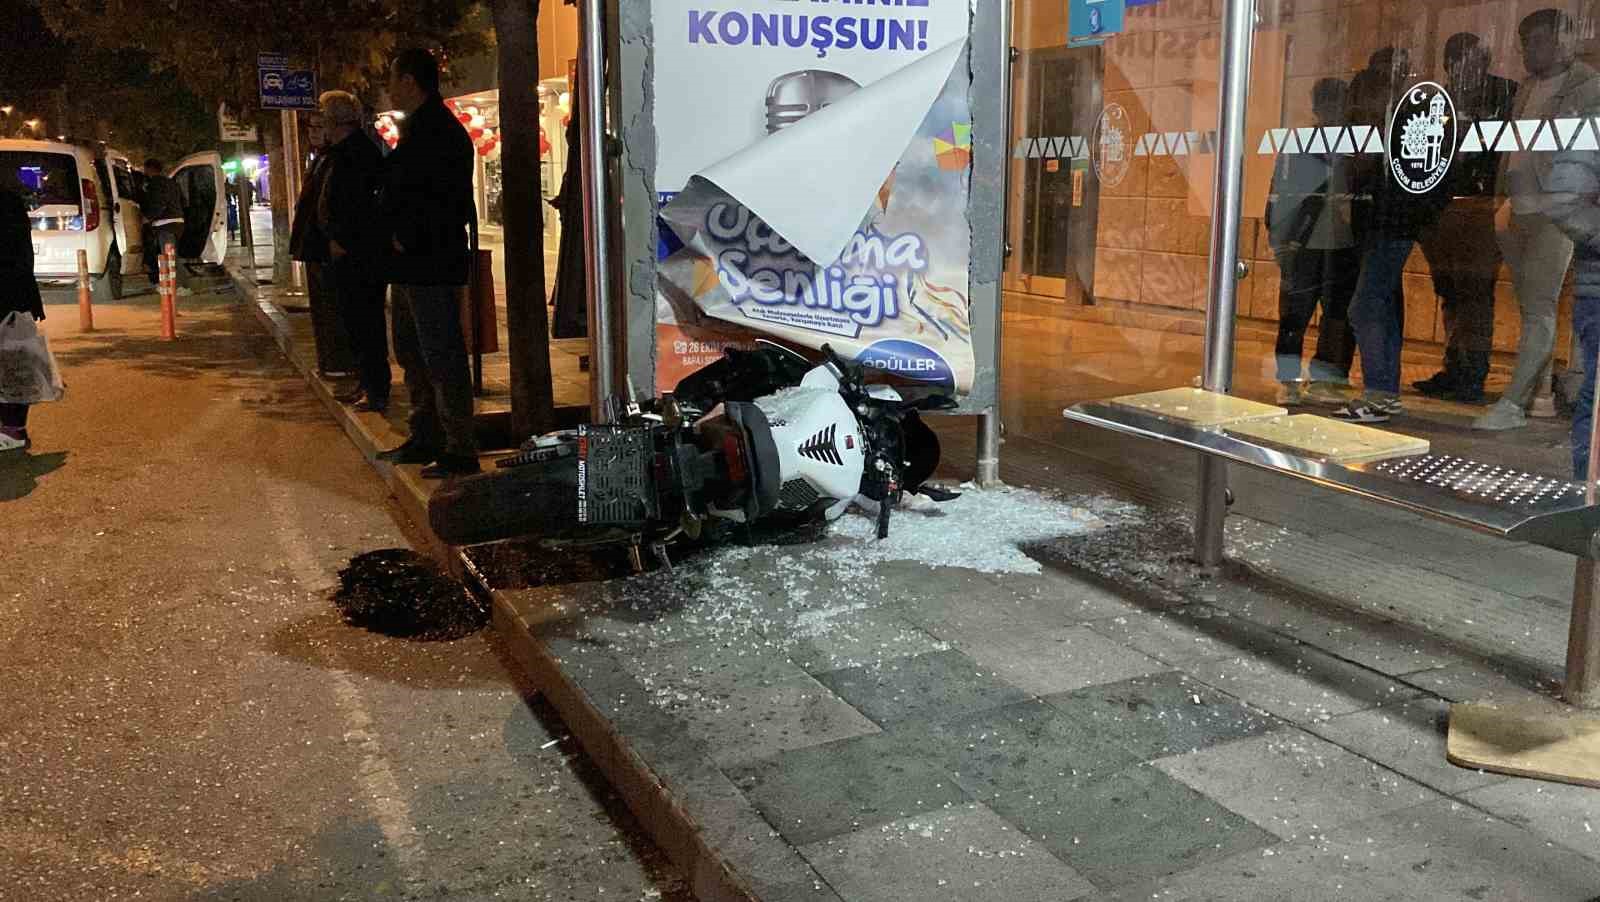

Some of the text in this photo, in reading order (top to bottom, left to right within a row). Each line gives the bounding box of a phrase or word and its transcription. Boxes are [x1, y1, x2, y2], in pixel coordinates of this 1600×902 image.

[688, 10, 929, 58] KONUŞSUN!
[1393, 158, 1410, 186] ÇORUM
[863, 356, 936, 371] ÖDÜLLER
